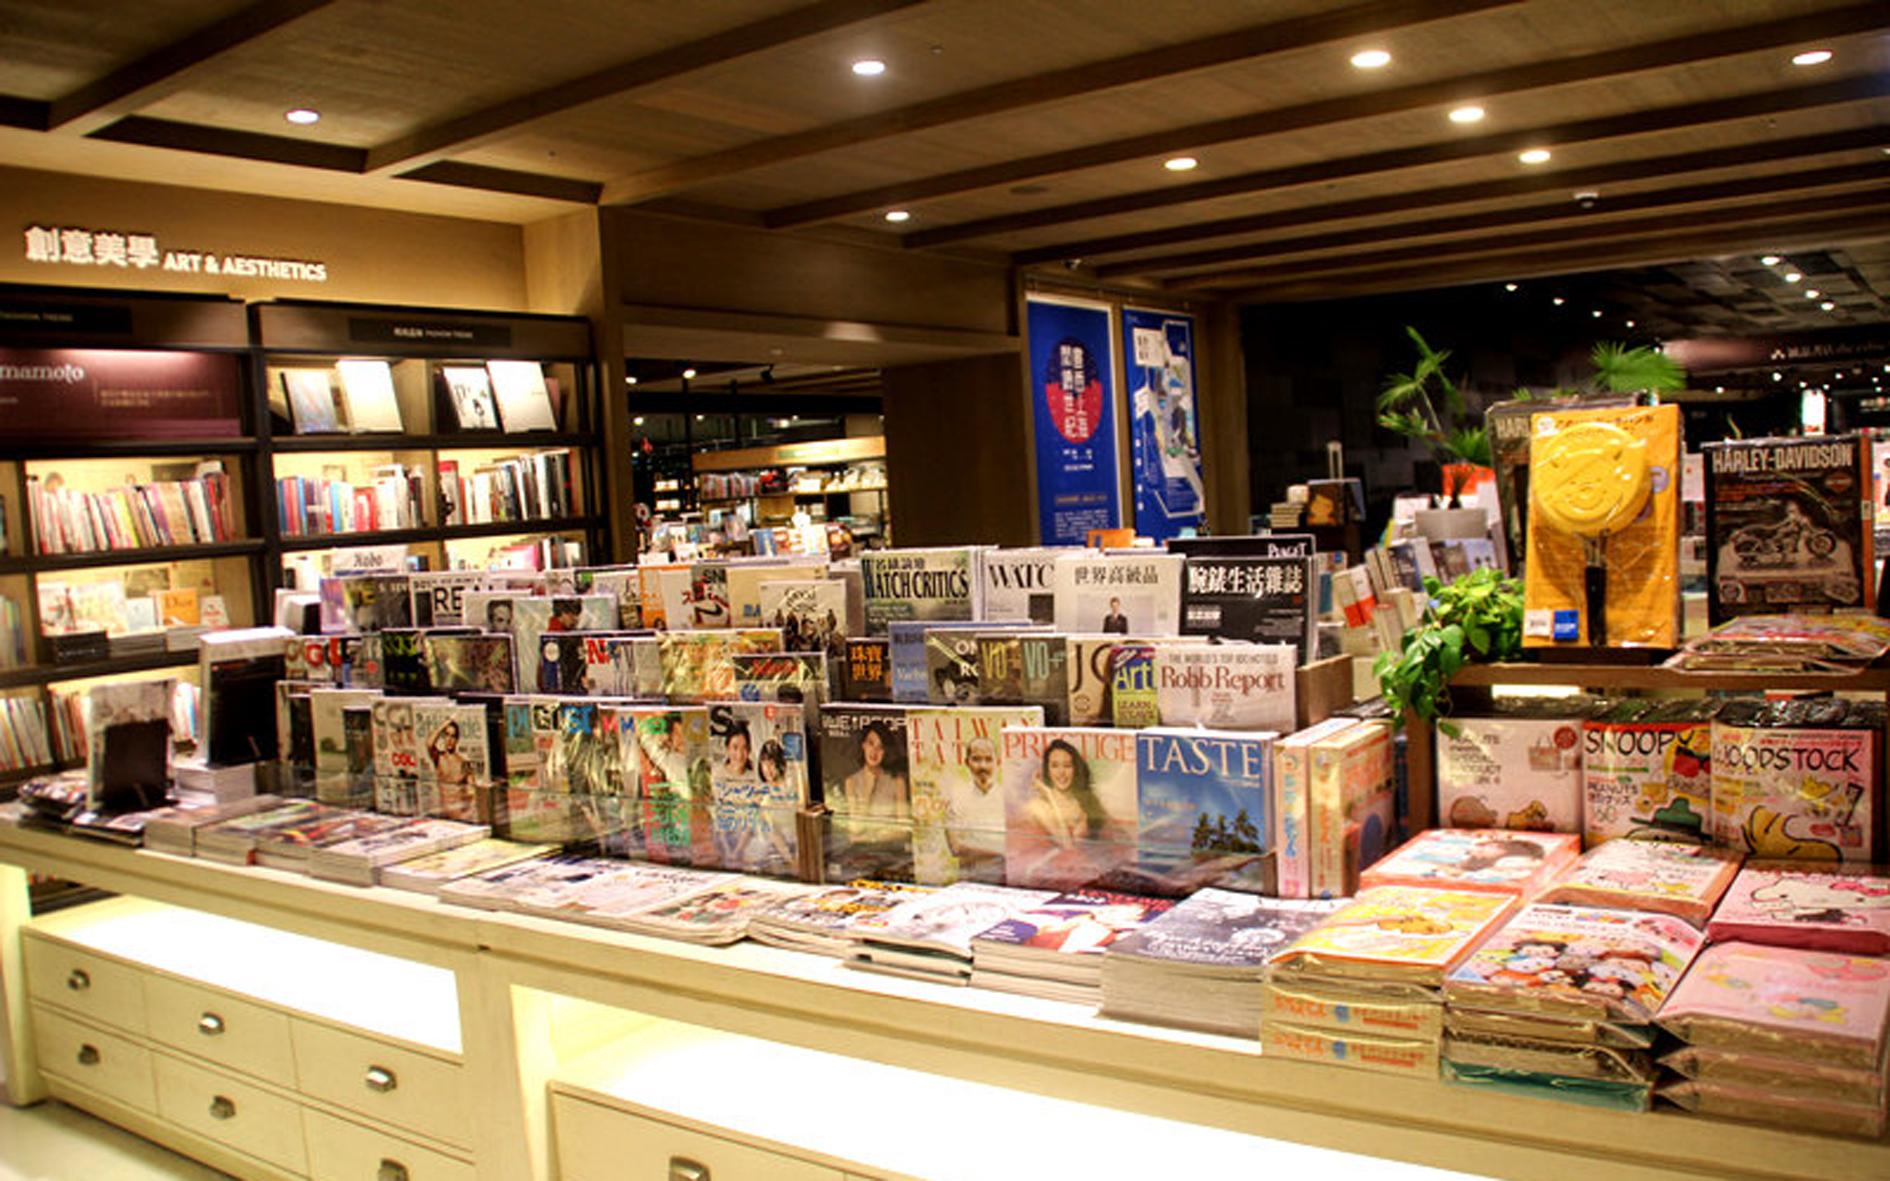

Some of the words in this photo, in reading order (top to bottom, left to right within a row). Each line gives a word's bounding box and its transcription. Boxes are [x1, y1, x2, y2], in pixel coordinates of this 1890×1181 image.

[24, 226, 159, 268] 創意美學
[163, 252, 203, 273] ART
[205, 254, 220, 274] &
[223, 256, 327, 281] AESTHETICS
[1712, 444, 1854, 473] HARLEY-DAVIDSON
[913, 569, 969, 598] CRITICS
[988, 564, 1055, 589] WATC
[1075, 565, 1159, 585] 世界高級品
[1187, 566, 1303, 598] 腕錶生活雜誌
[1160, 665, 1212, 688] Robb
[1215, 665, 1285, 696] Report
[1003, 732, 1135, 763] PRETIGE
[1138, 736, 1262, 779] TASTE
[1585, 729, 1696, 756] SNOOPY
